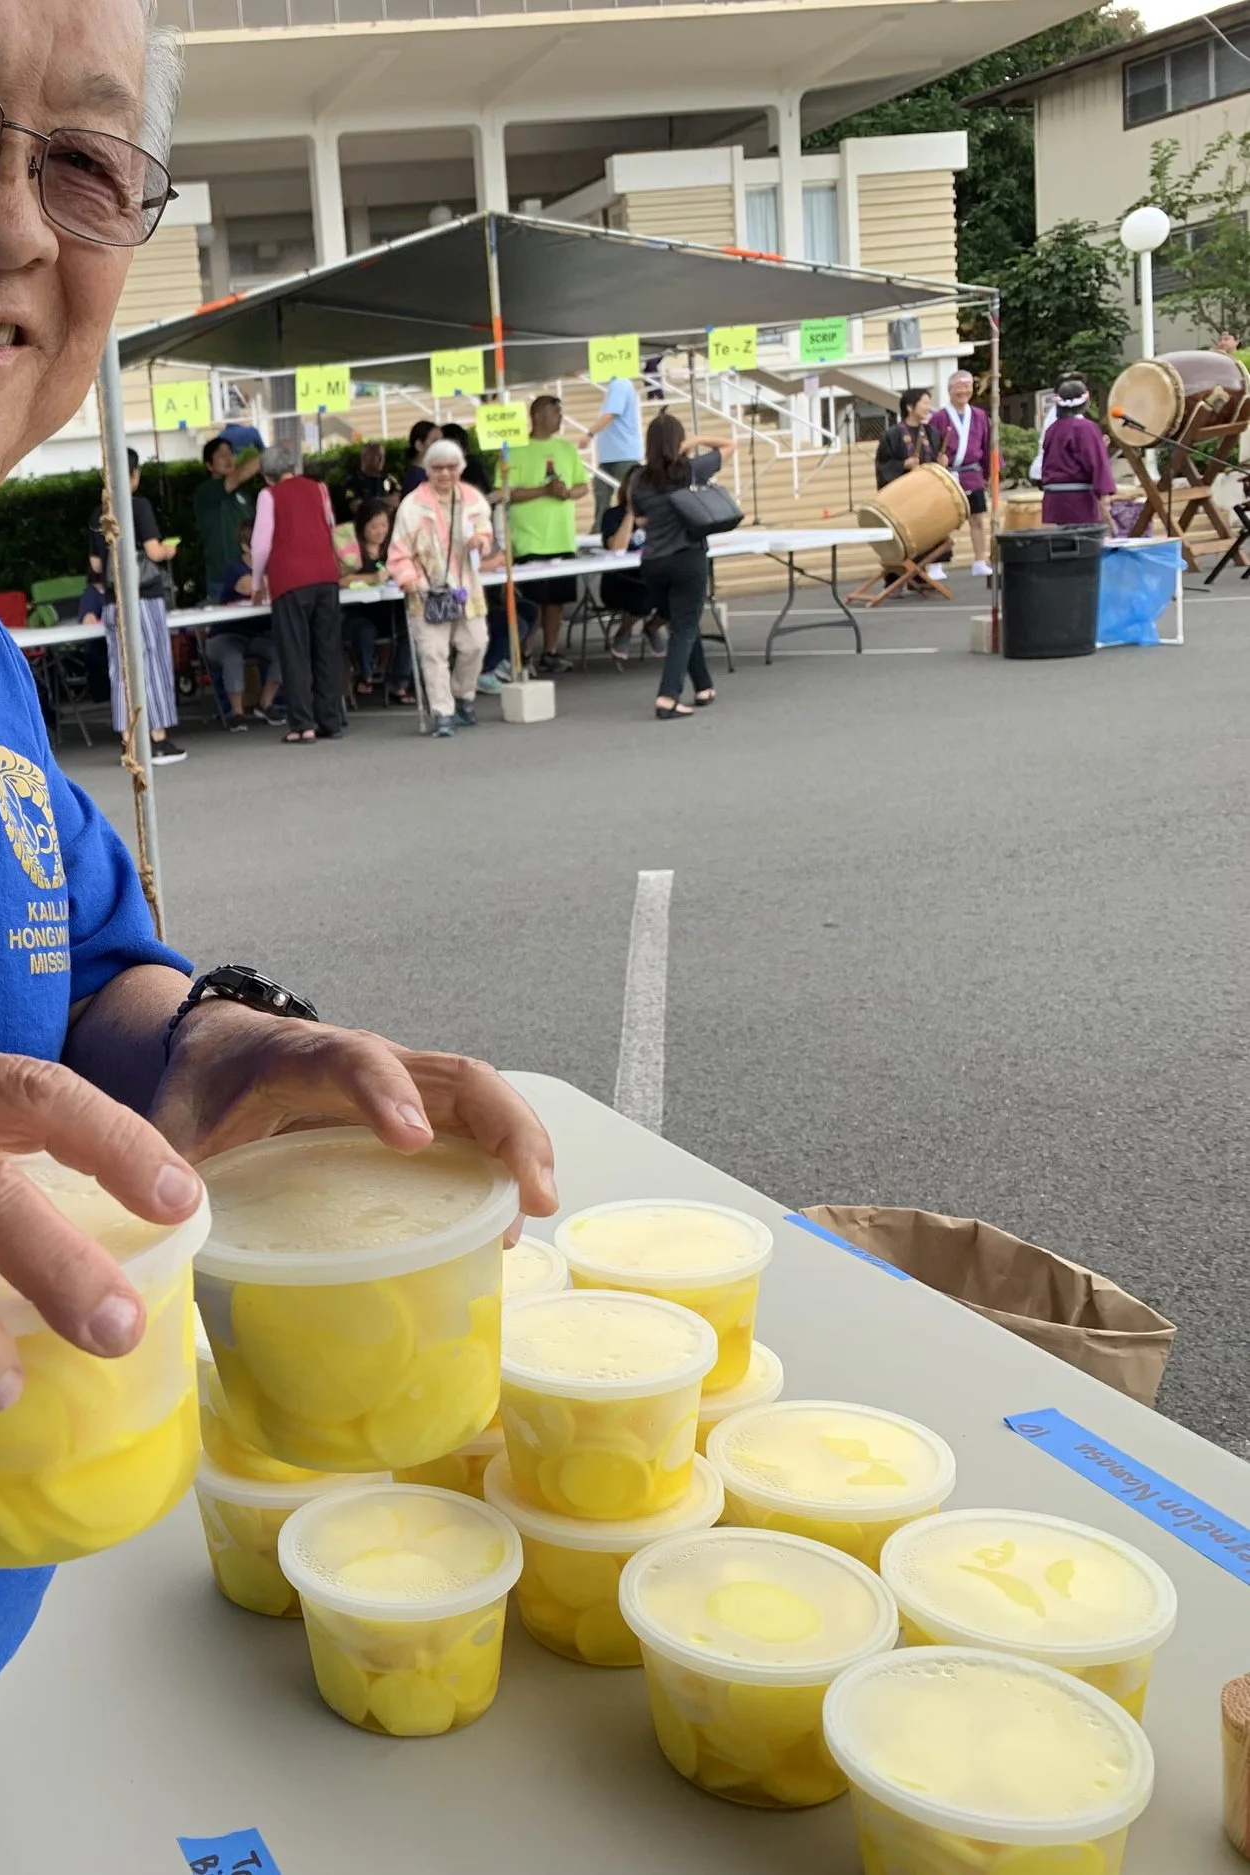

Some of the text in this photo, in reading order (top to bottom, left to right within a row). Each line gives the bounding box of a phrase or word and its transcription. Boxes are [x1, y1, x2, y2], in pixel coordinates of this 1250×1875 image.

[809, 332, 838, 344] SCRIP
[713, 342, 730, 356] Te
[743, 340, 752, 353] Z
[300, 381, 310, 397] J
[326, 380, 346, 397] Mi
[164, 397, 178, 414] A
[27, 900, 69, 922] KAILU
[9, 926, 69, 950] HONGW
[30, 951, 71, 975] MISSI
[1157, 1499, 1250, 1574] ermelon
